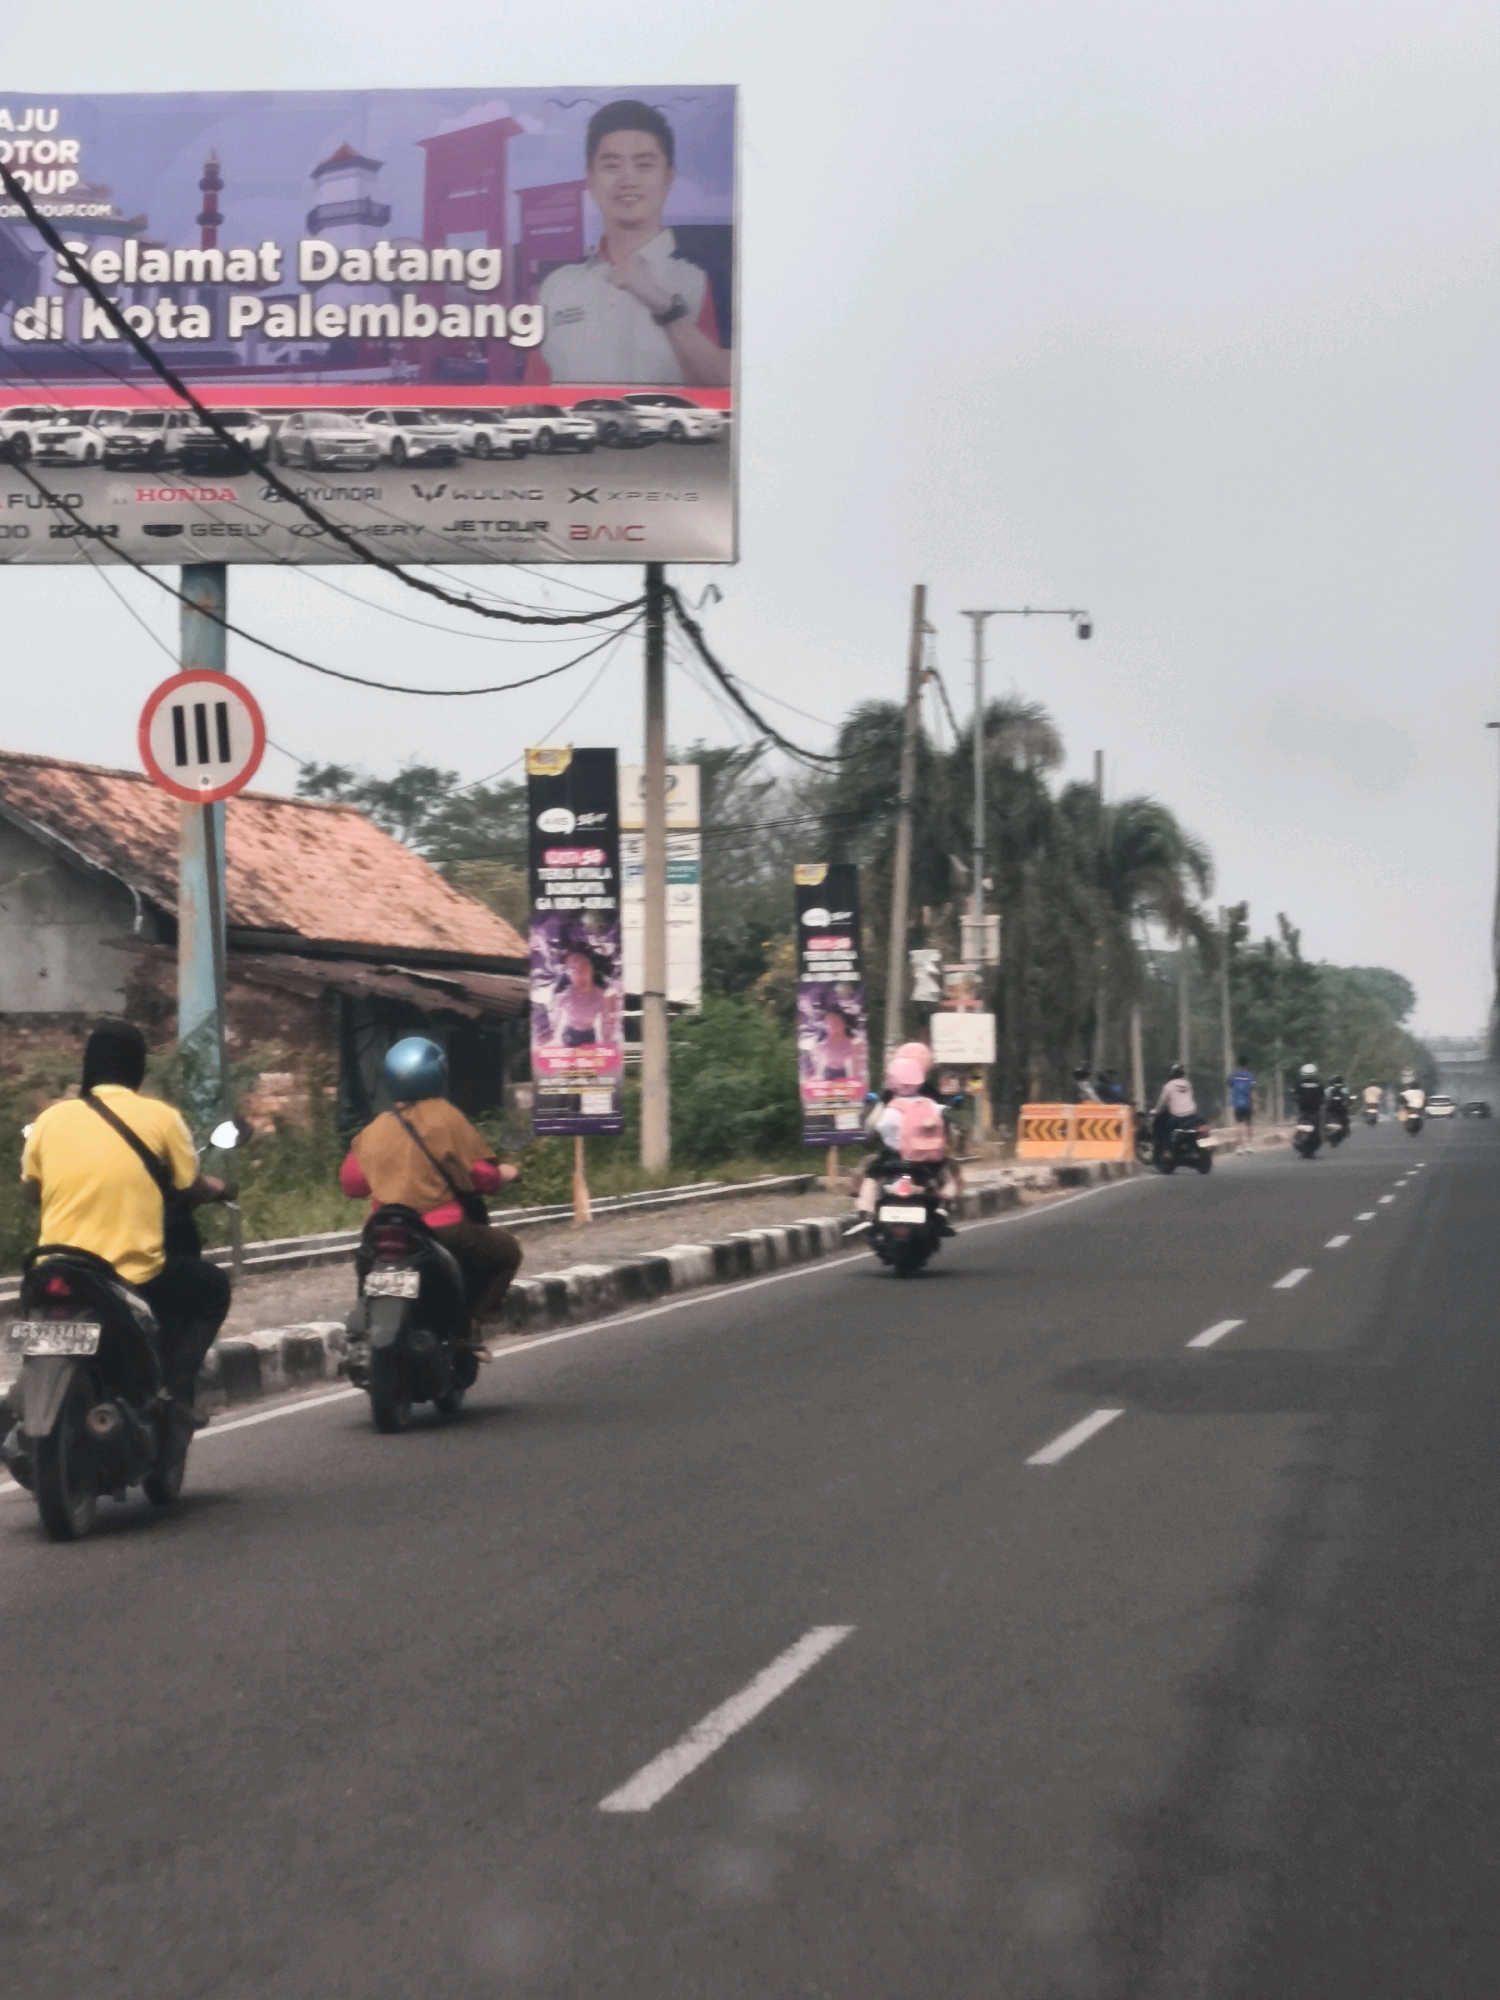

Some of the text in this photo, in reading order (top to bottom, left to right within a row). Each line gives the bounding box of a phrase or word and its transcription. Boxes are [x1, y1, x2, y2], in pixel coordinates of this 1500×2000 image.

[55, 239, 502, 290] Selamat Datang
[13, 296, 64, 340] di
[82, 297, 210, 340] Kota
[228, 294, 544, 347] Palembang
[7, 493, 83, 509] FUSO
[136, 488, 237, 501] HONDA
[189, 523, 270, 537] GEELY
[443, 520, 549, 532] JETOUR
[569, 524, 645, 542] BAIC
